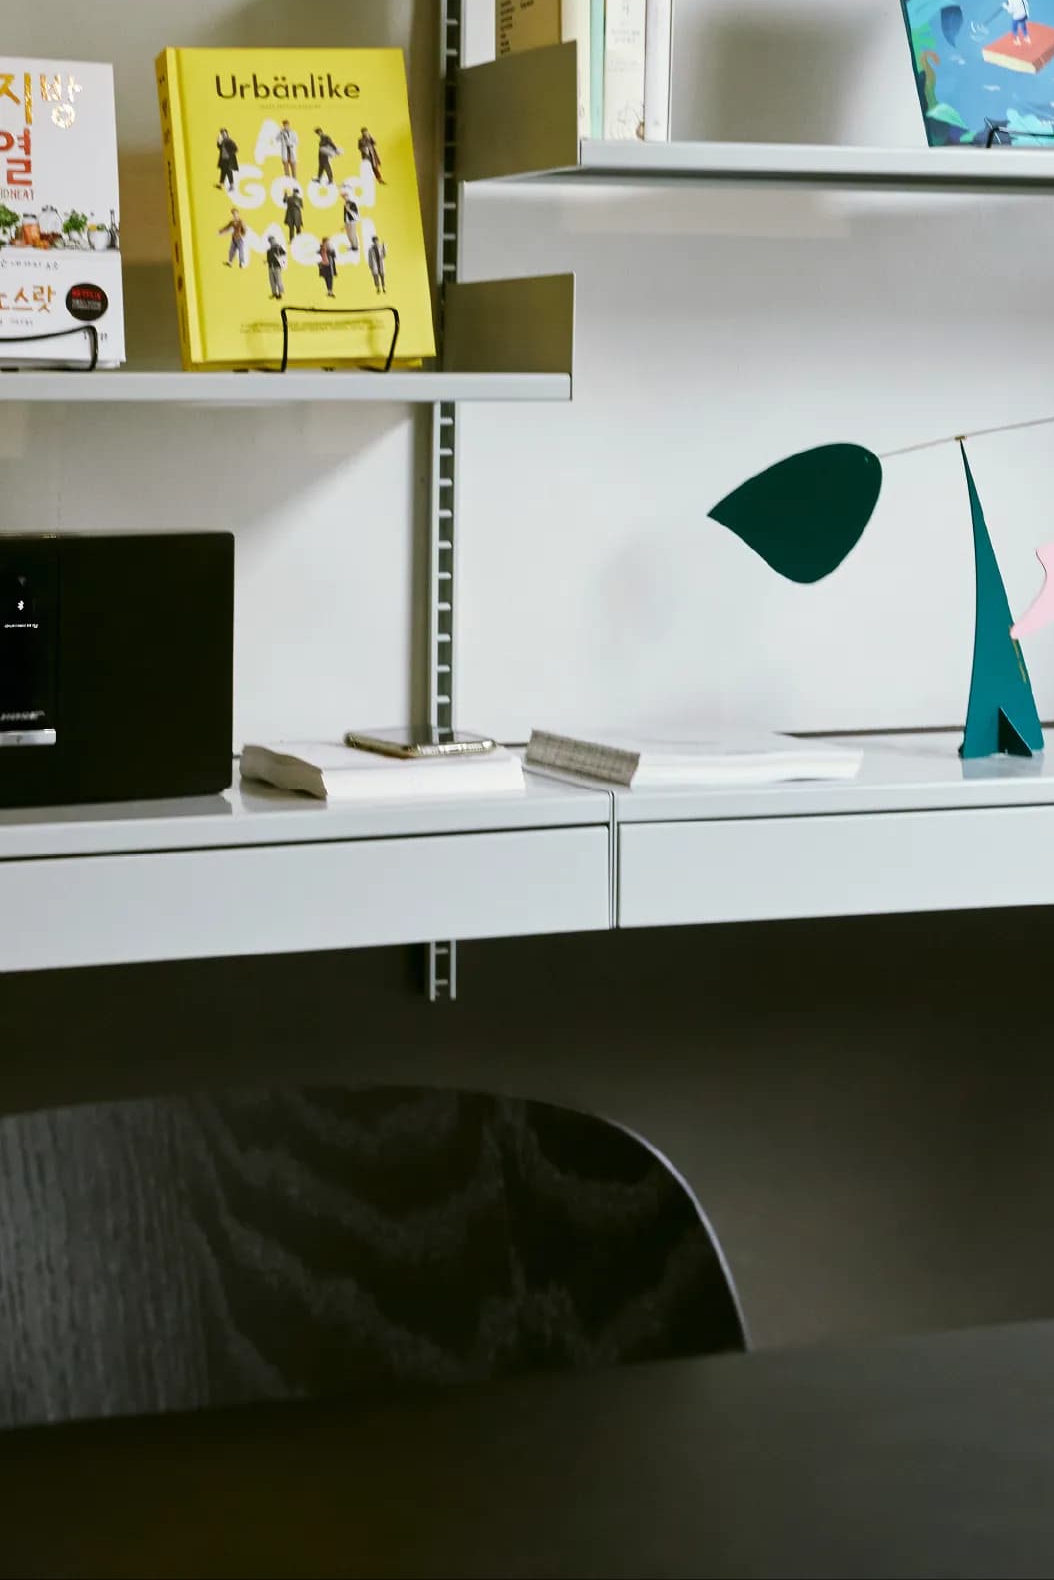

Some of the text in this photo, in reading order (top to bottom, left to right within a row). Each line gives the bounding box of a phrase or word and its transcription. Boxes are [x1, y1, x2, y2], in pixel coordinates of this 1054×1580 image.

[215, 74, 361, 100] Urbänlike
[226, 158, 377, 210] Good
[243, 216, 378, 267] Meal
